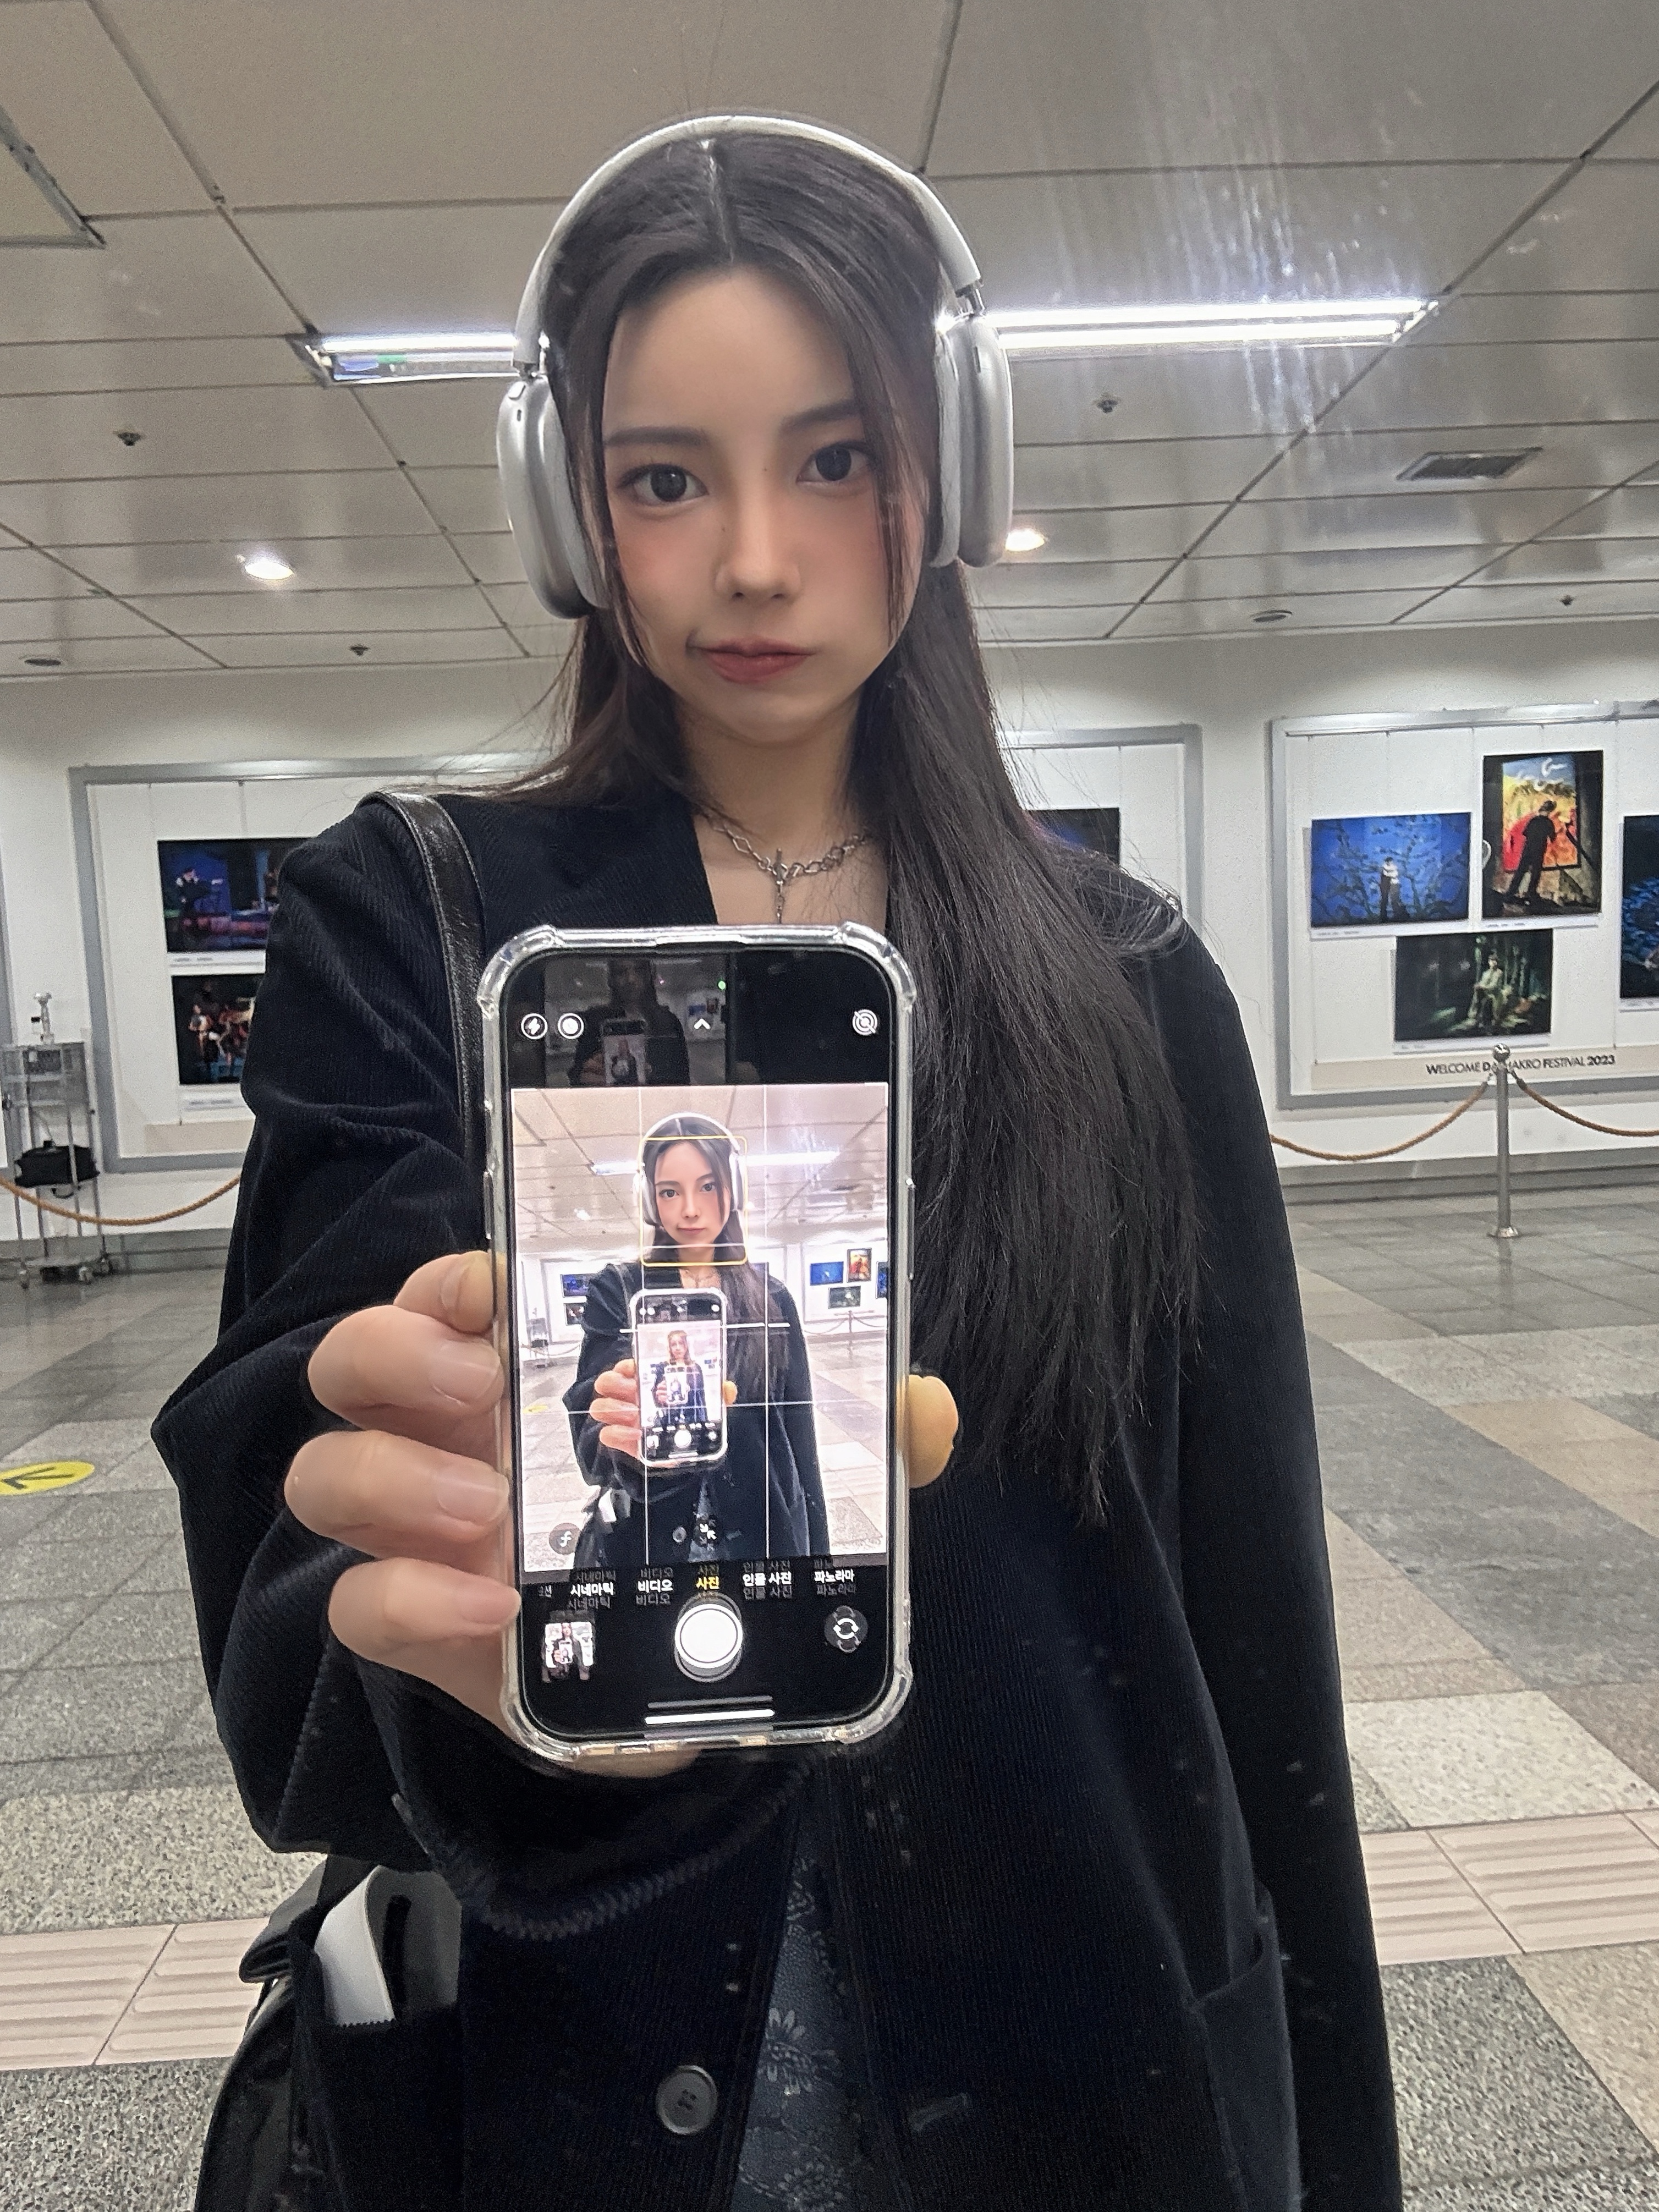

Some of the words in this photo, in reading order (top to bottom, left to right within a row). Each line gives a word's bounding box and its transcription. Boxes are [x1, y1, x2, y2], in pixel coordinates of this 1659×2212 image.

[1425, 1061, 1481, 1074] WELCOME
[1542, 1056, 1585, 1069] FESTIVAL
[1586, 1054, 1616, 1066] 2023
[570, 1581, 614, 1597] 시네마틱
[637, 1579, 673, 1593] 비디오
[696, 1575, 719, 1590] 사진
[742, 1572, 766, 1587] 인물
[768, 1571, 793, 1585] 사진
[814, 1568, 855, 1584] 파노라마
